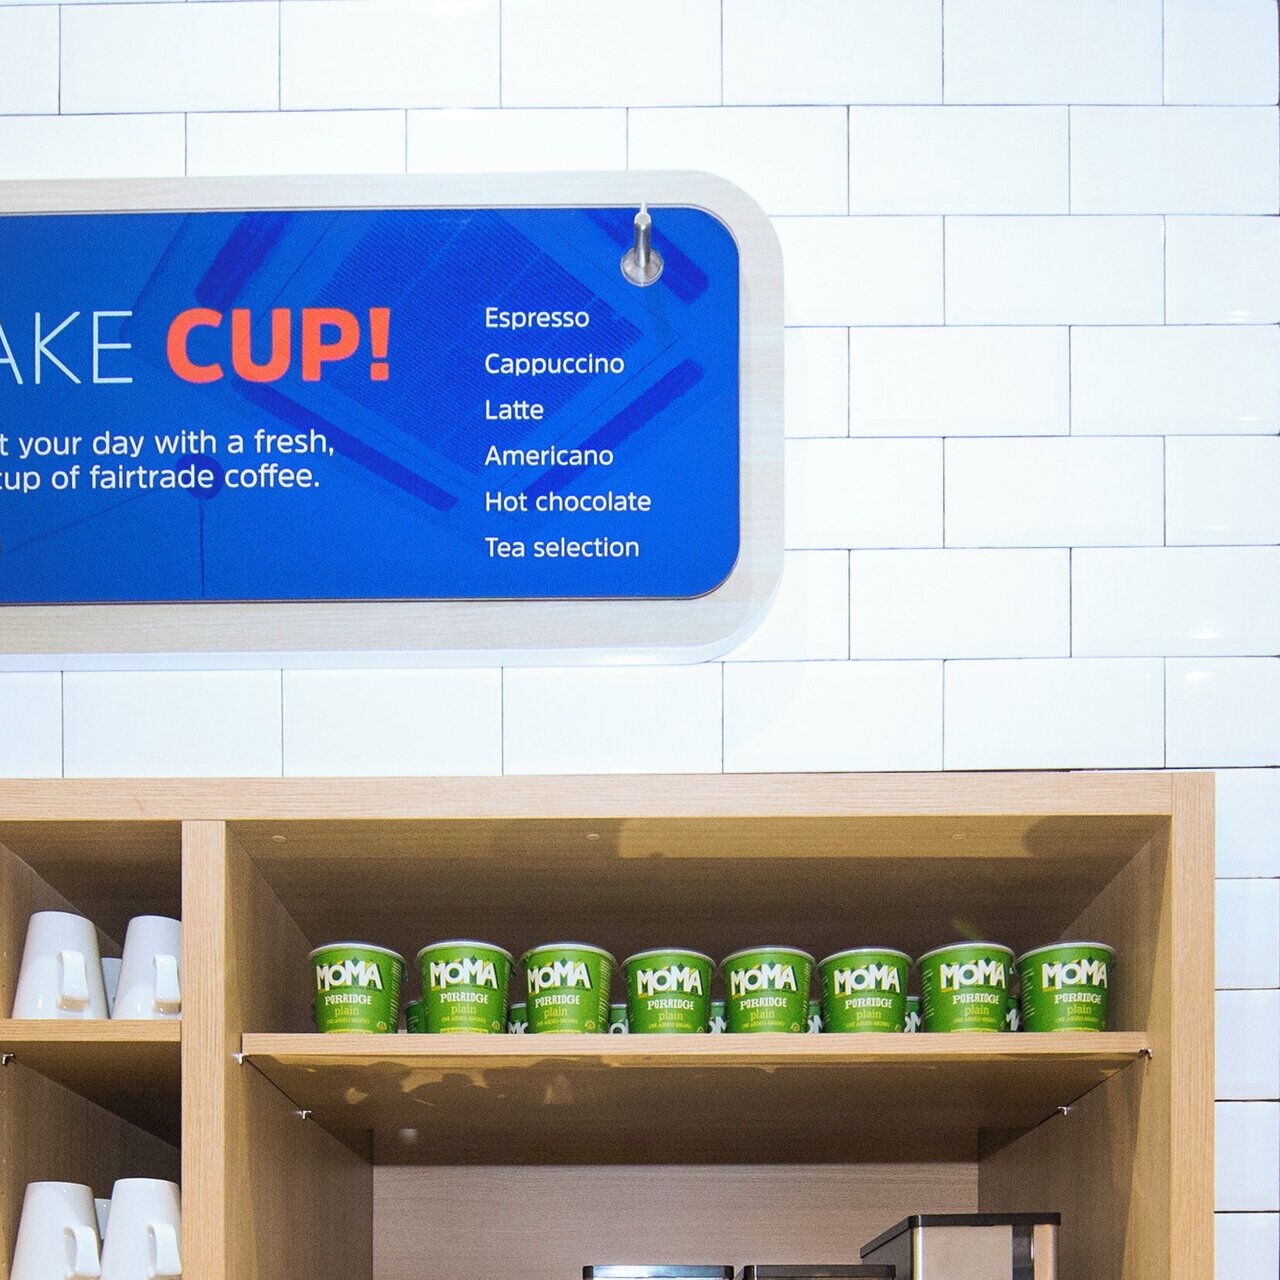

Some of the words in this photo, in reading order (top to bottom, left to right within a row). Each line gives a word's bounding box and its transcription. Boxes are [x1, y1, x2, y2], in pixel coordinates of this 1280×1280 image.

[485, 307, 590, 330] Espresso
[166, 307, 391, 384] CUP!
[485, 353, 624, 376] Cappuccino
[485, 399, 544, 420] Latte
[18, 437, 82, 460] your
[92, 431, 143, 457] day
[155, 429, 217, 455] with
[227, 435, 244, 454] a
[254, 429, 335, 456] fresh,
[485, 445, 614, 466] Americano
[51, 464, 80, 490] of
[89, 463, 214, 489] fairtrade
[224, 463, 321, 488] coffee.
[485, 491, 528, 512] Hot
[536, 490, 652, 512] chocolate
[485, 537, 525, 558] Tea
[534, 537, 640, 558] selection
[316, 960, 384, 991] MOMA
[430, 958, 498, 990] MOMA
[527, 961, 592, 994] MOMA
[637, 965, 703, 997] MOMA
[731, 963, 797, 997] MOMA
[833, 963, 901, 996] MOMA
[940, 959, 1006, 990] MOMA
[1042, 958, 1108, 990] MOMA
[325, 993, 372, 1005] PORRIDGE
[440, 992, 489, 1004] PORRIDGE
[535, 994, 581, 1008] PORRIDGE
[647, 998, 695, 1010] PORRIDGE
[740, 996, 788, 1010] PORRIDGE
[845, 996, 892, 1010] PORRIDGE
[952, 992, 999, 1005] PORRIDGE
[1054, 992, 1101, 1005] PORRIDGE
[334, 1005, 360, 1016] plain
[451, 1004, 477, 1016] plain
[544, 1006, 568, 1019] plain
[658, 1010, 683, 1022] plain
[750, 1009, 775, 1021] plain
[857, 1009, 882, 1021] plain
[965, 1004, 990, 1016] plain
[1067, 1004, 1092, 1016] plain
